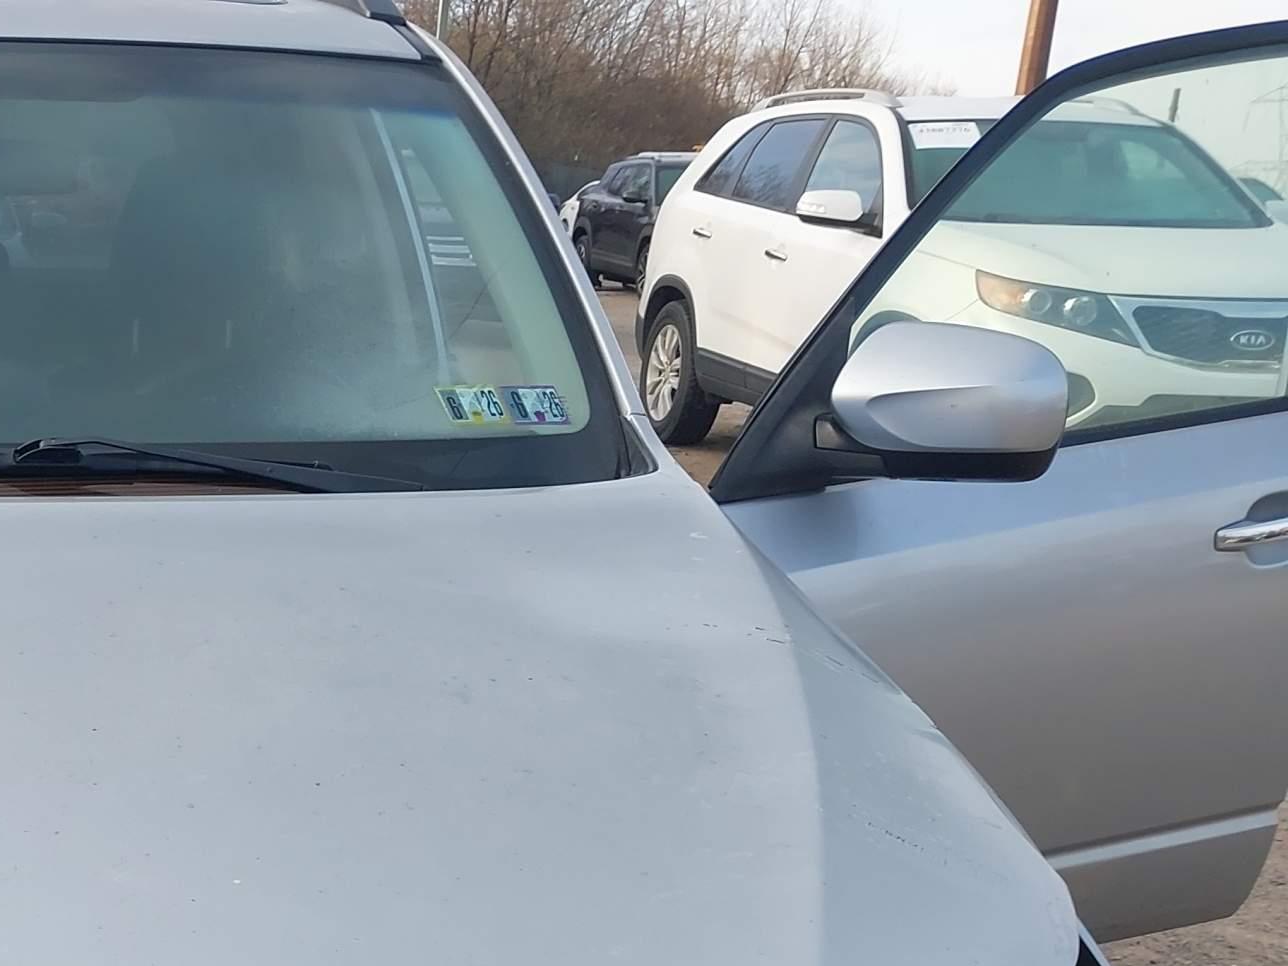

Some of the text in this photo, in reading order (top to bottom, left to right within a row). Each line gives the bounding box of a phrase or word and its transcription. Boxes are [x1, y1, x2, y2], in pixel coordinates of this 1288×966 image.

[1239, 335, 1267, 346] KIA
[446, 396, 463, 420] 6
[510, 391, 528, 418] 6
